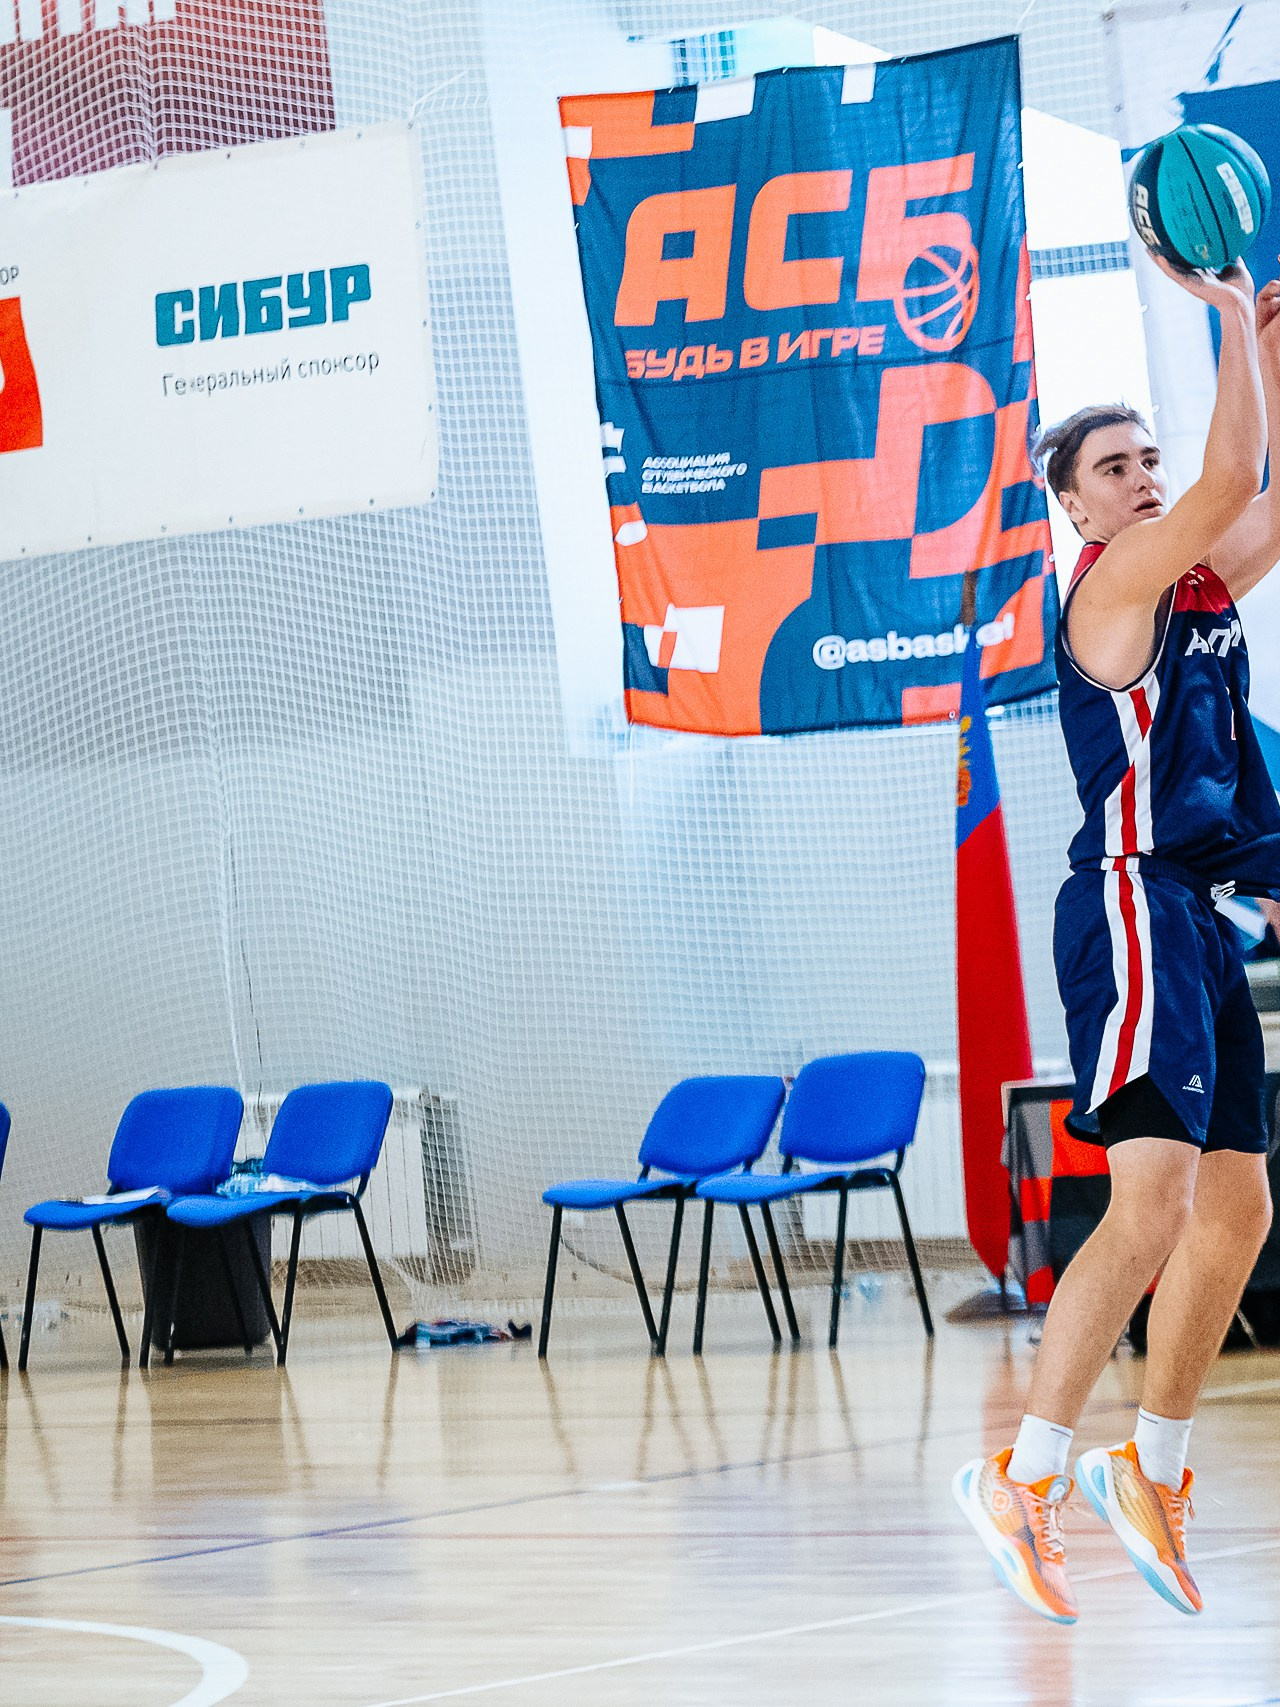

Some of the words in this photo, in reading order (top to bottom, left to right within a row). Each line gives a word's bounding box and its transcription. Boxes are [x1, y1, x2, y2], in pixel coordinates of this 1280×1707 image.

[614, 152, 976, 327] АСБ
[155, 263, 371, 347] СИБУР
[297, 351, 380, 384] спонсор
[625, 344, 733, 381] БУДЬ
[739, 336, 769, 369] В
[776, 324, 886, 364] ИГРЕ
